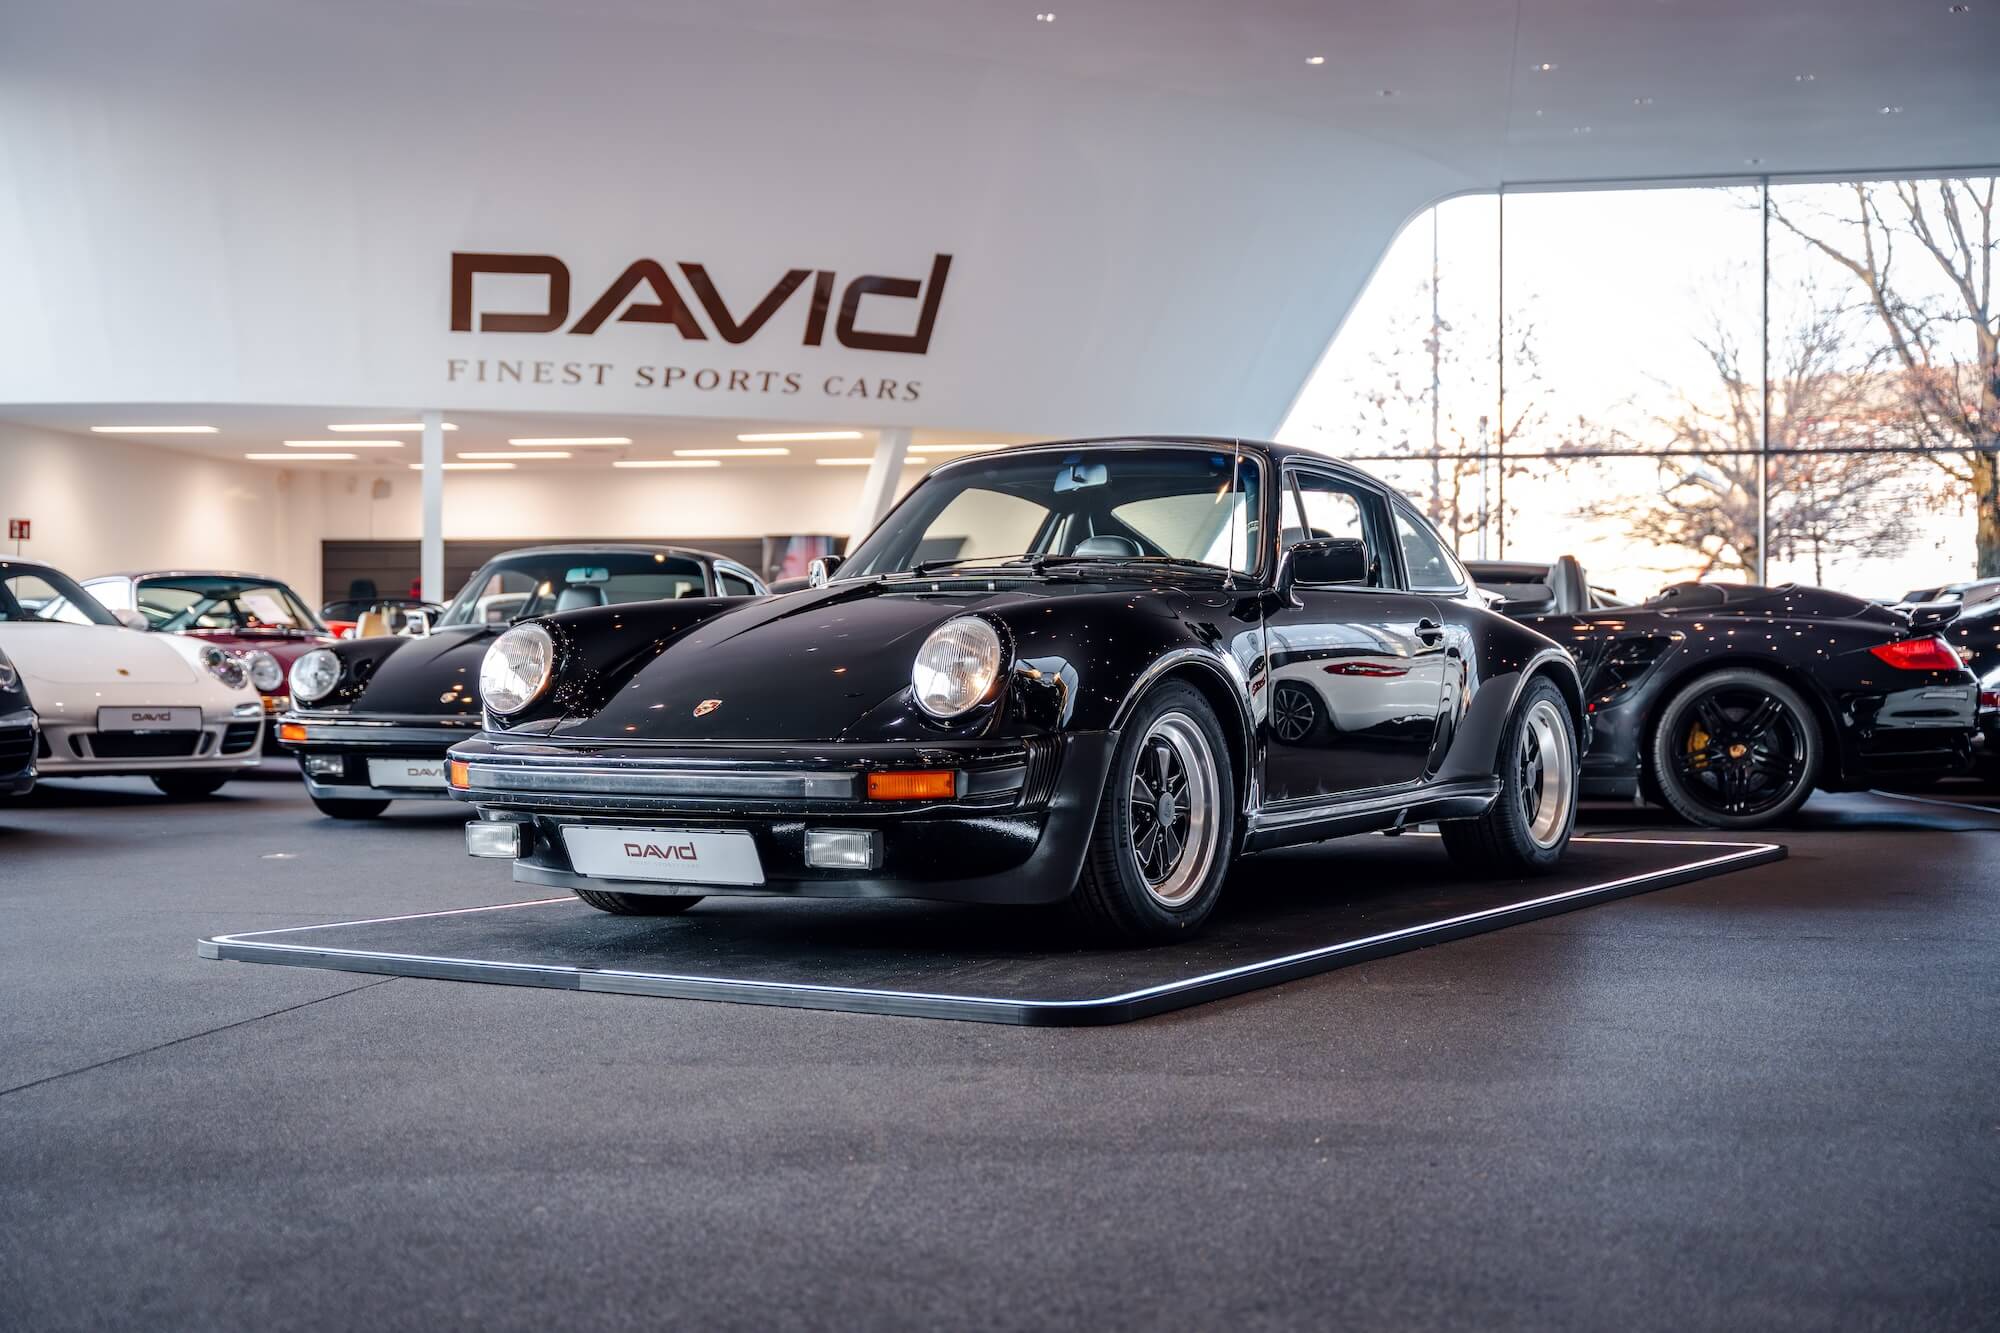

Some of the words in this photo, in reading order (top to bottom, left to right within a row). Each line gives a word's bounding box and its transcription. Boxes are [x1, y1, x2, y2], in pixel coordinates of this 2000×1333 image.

[446, 358, 614, 386] FINEST
[634, 365, 802, 395] SPORTS
[823, 375, 922, 402] CARS
